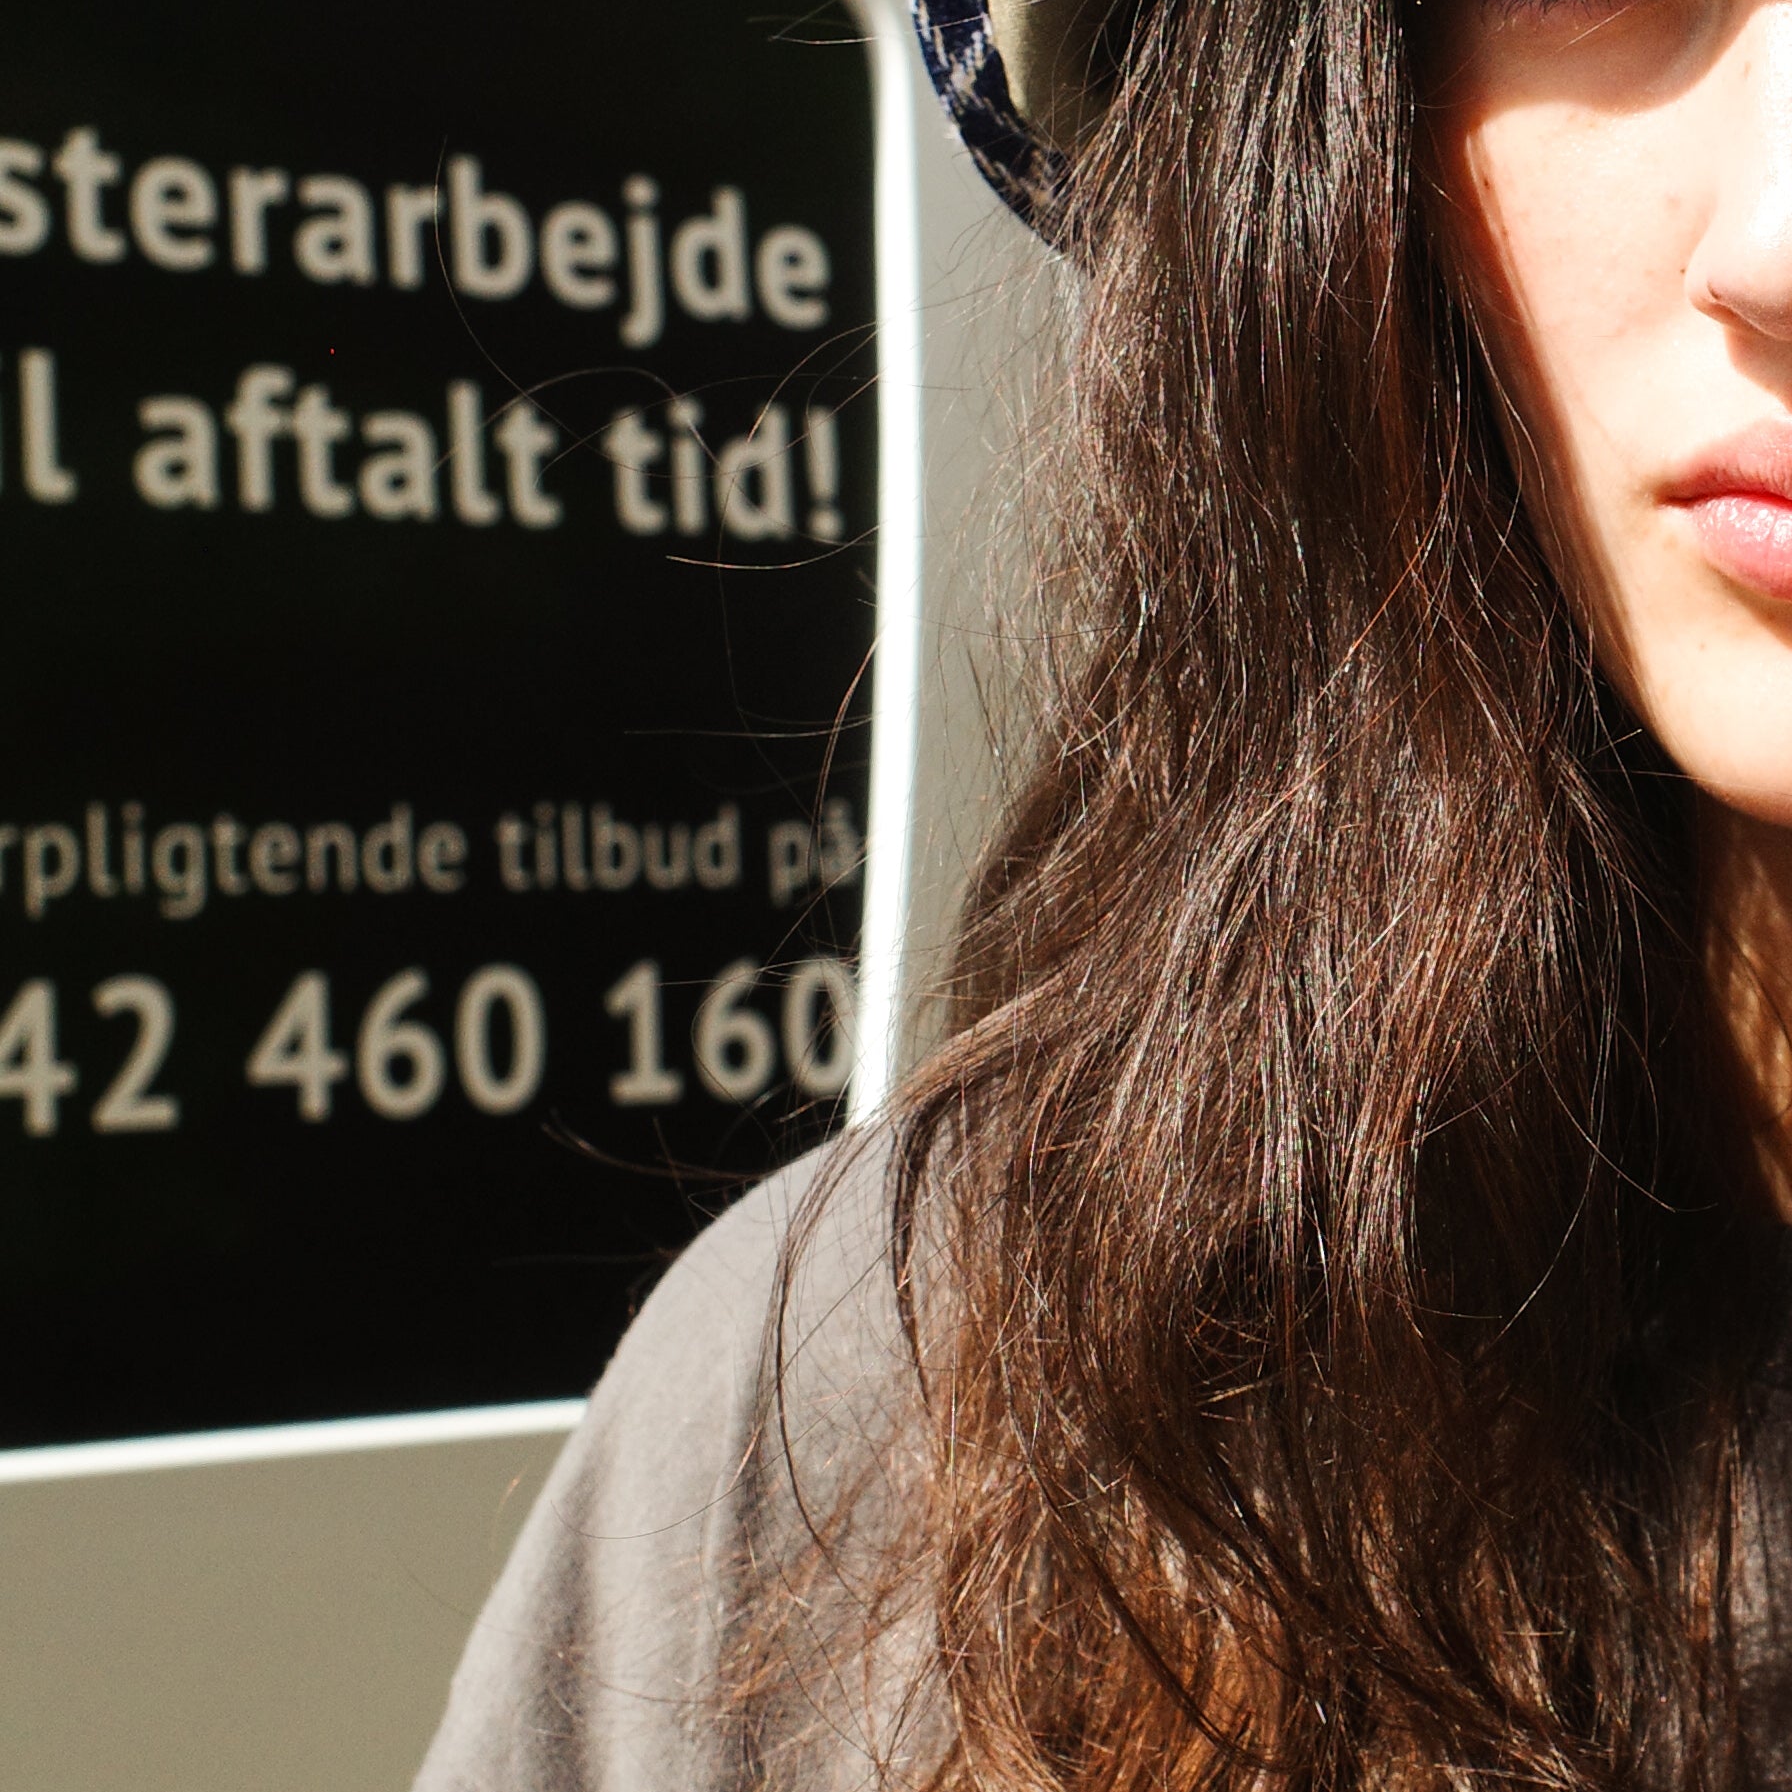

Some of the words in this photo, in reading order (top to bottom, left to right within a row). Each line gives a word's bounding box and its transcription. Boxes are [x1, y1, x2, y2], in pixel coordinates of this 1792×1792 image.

[0, 127, 832, 347] sterarbejde
[132, 362, 562, 526] aftalt
[604, 402, 846, 540] tid!
[495, 799, 742, 891] tilbud
[0, 972, 180, 1135] 42
[247, 961, 546, 1123] 460
[604, 955, 858, 1107] 160
